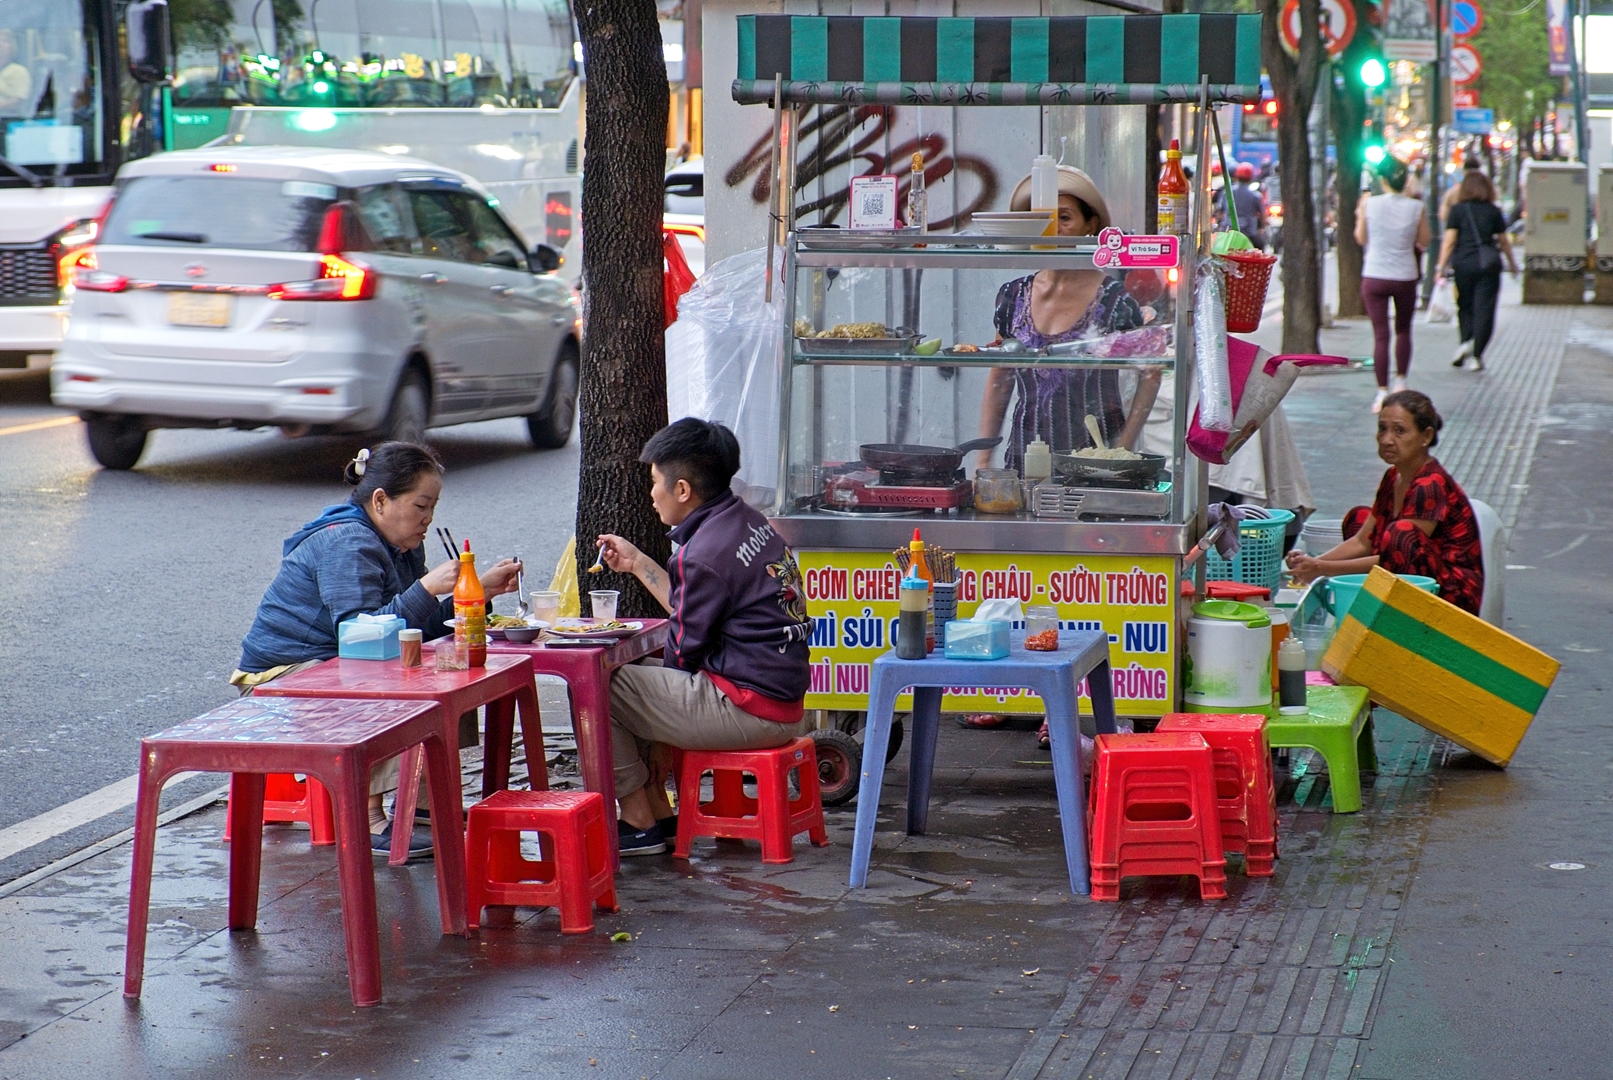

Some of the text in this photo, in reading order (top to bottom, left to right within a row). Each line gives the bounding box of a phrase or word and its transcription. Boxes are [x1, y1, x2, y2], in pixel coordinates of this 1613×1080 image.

[807, 566, 847, 600] CƠM
[982, 565, 1031, 602] CHÂU
[1050, 565, 1101, 604] SƯỜN
[1106, 567, 1167, 605] TRỨNG
[843, 609, 882, 648] SỦI
[1125, 622, 1166, 652] NUI
[807, 658, 868, 693] MÌ NUI
[1110, 663, 1166, 699] RỨNG
